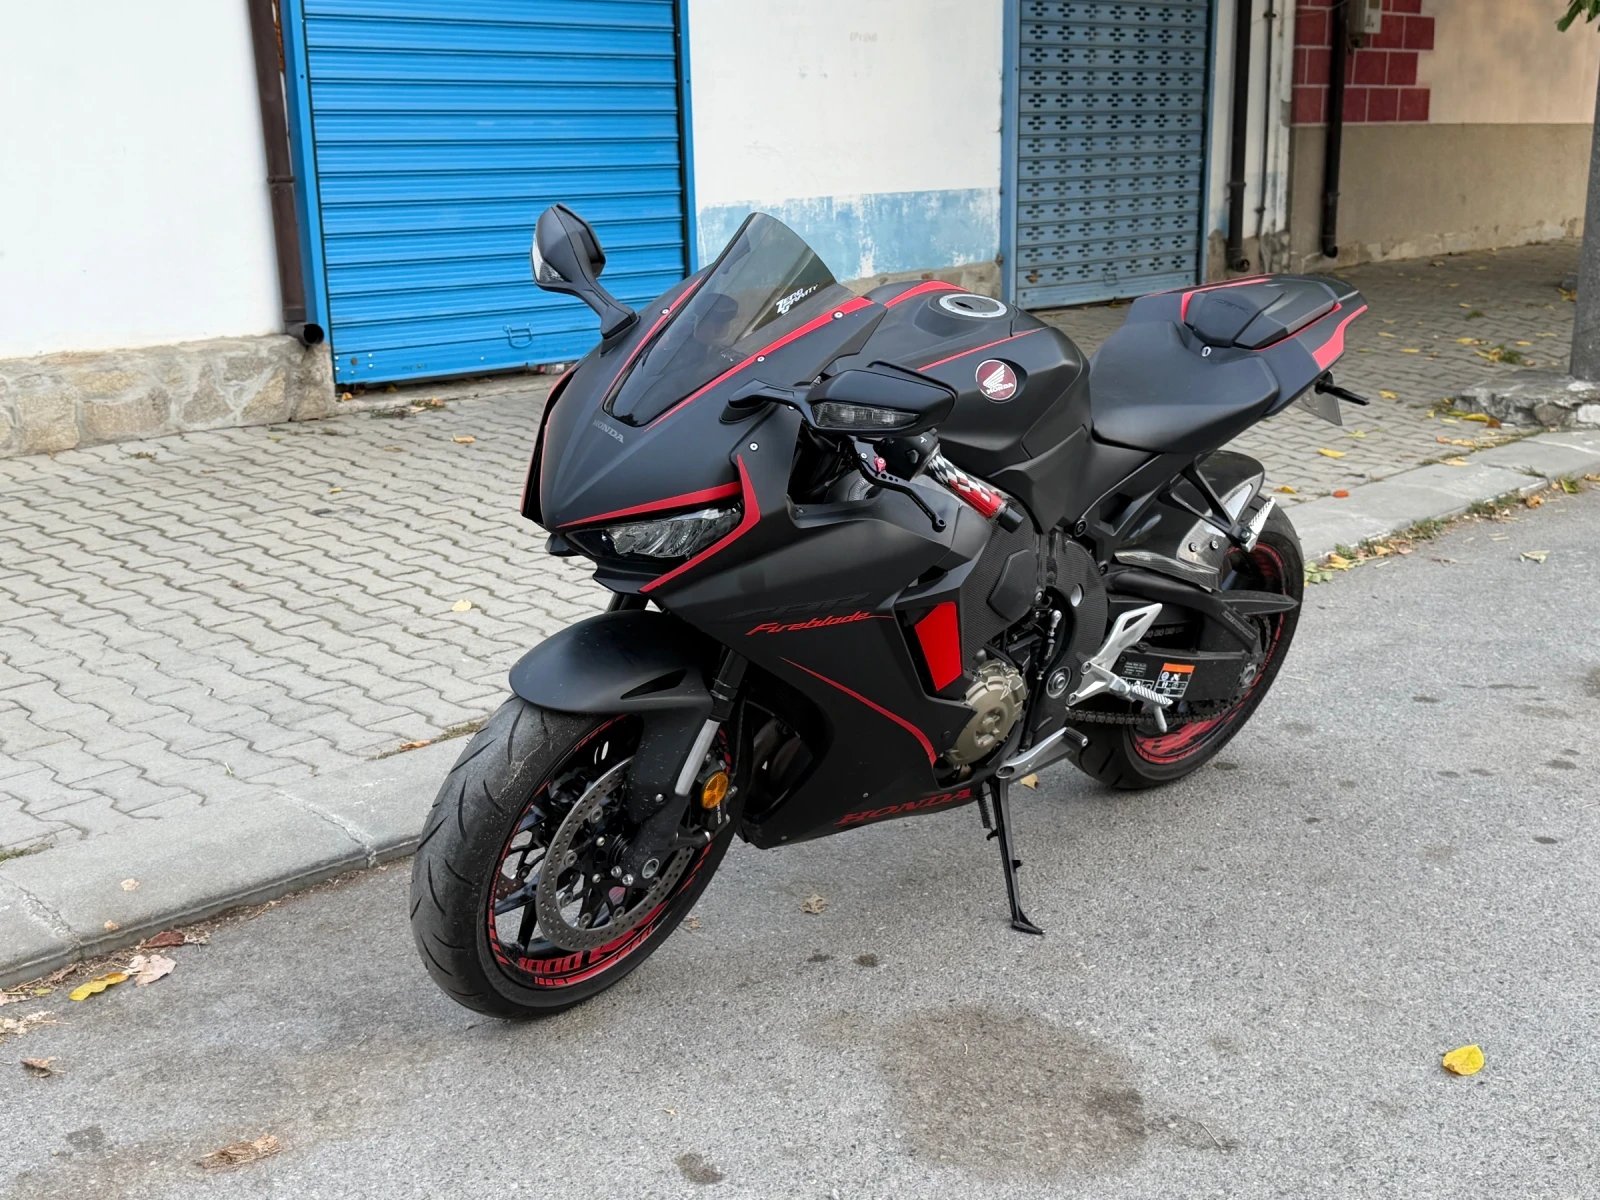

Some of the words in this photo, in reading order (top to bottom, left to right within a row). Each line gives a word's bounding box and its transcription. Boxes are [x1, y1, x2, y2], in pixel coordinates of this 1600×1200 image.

[986, 382, 1014, 394] HONDA
[592, 419, 624, 444] HONDA
[745, 610, 870, 636] Fireblade
[834, 788, 972, 825] HONDA
